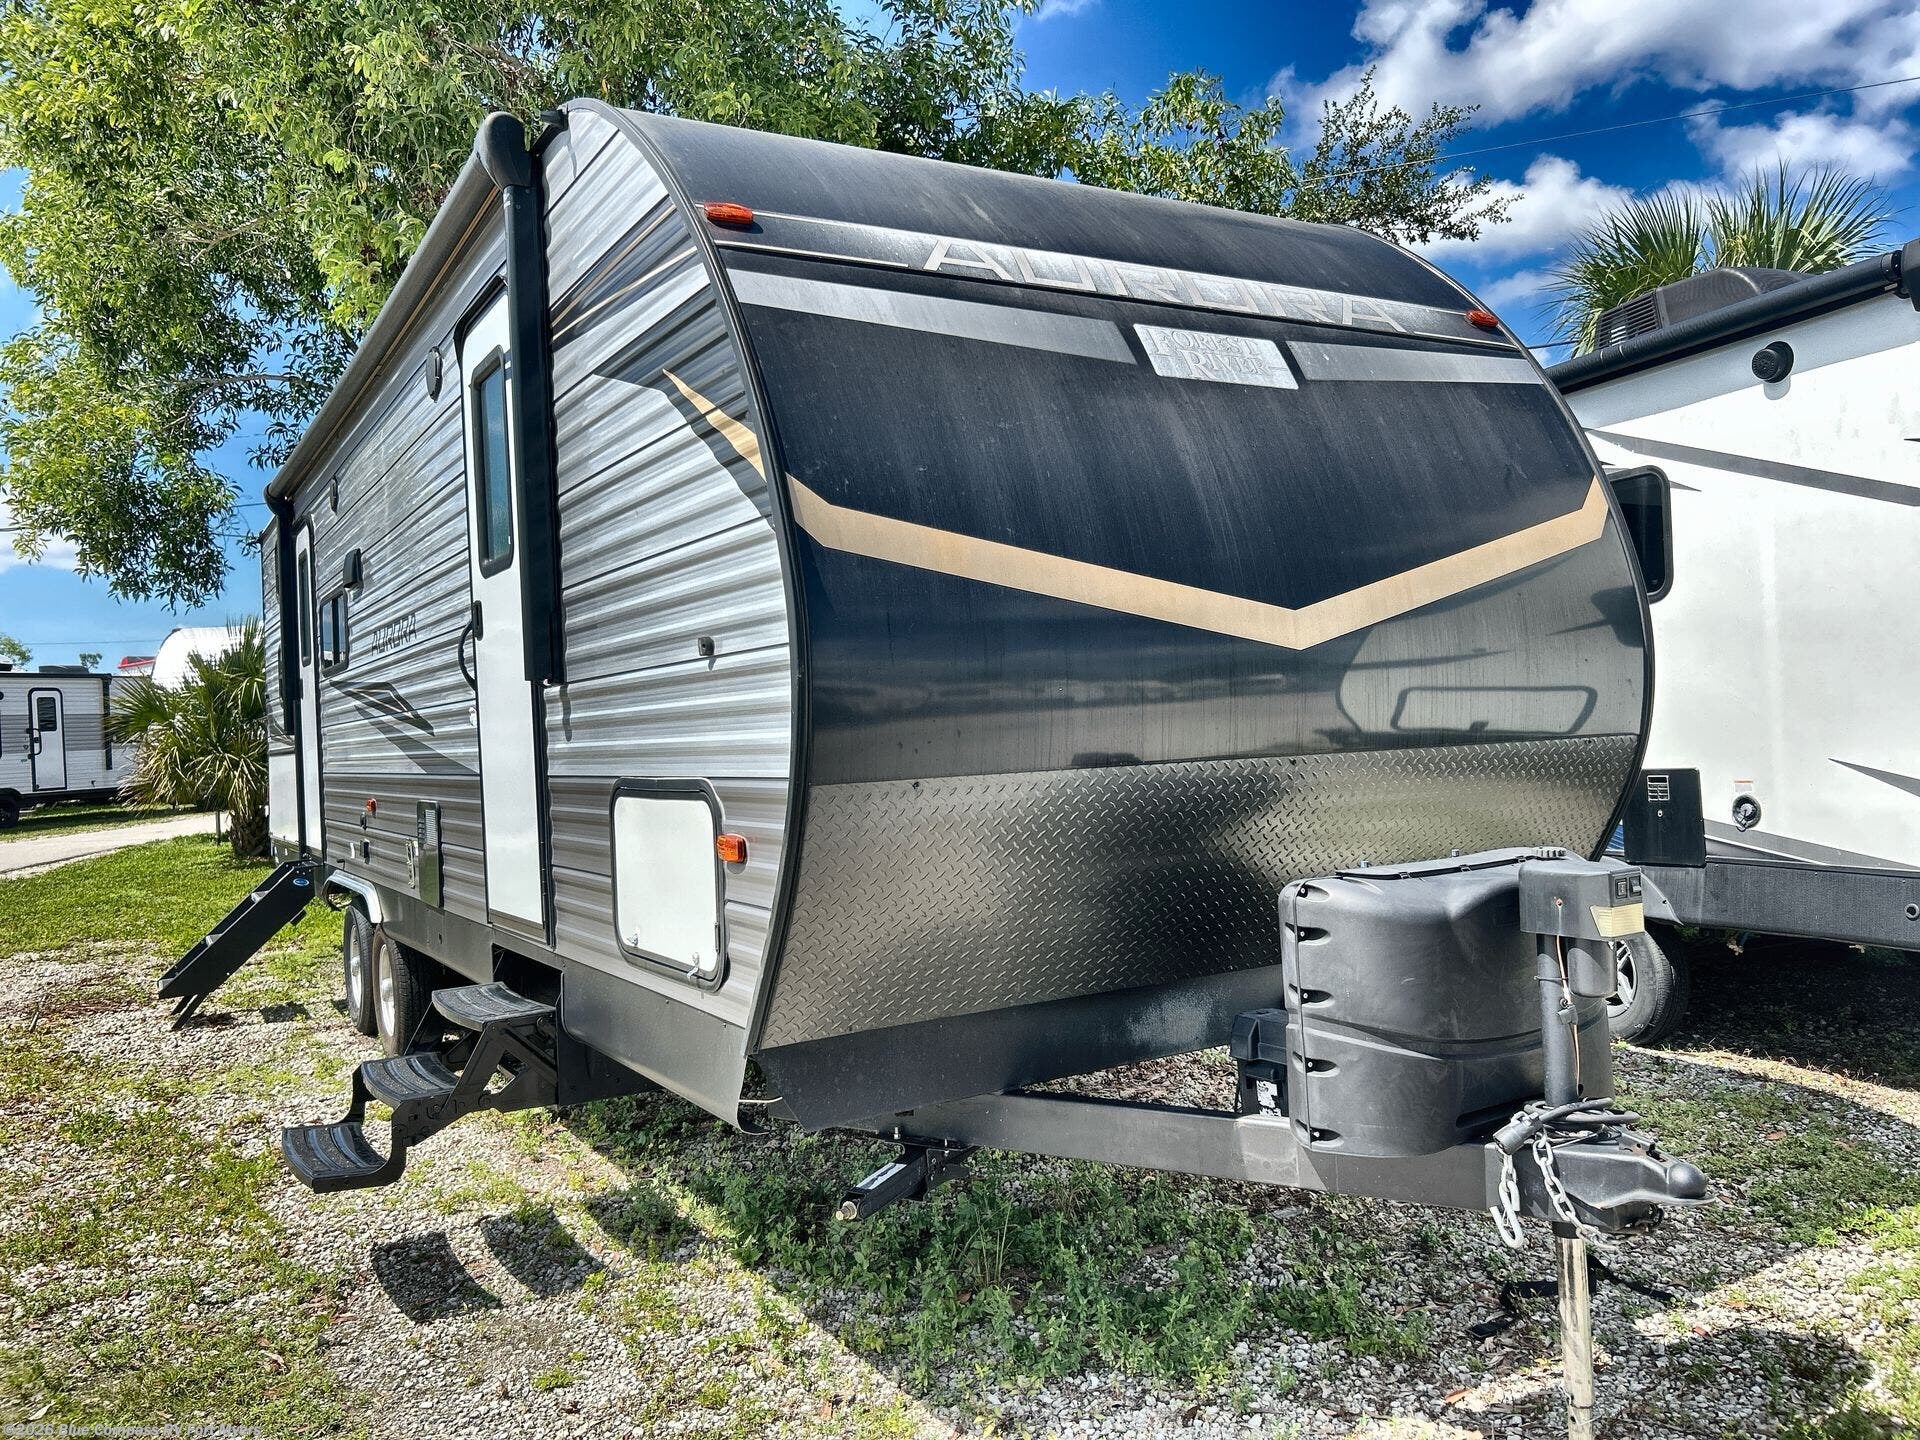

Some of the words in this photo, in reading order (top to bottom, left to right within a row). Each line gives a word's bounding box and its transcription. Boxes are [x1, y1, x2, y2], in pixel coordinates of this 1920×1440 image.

[922, 239, 1408, 333] AURORA
[1146, 328, 1259, 356] FOREST
[1179, 350, 1269, 379] RIVER
[371, 612, 417, 656] AURORA
